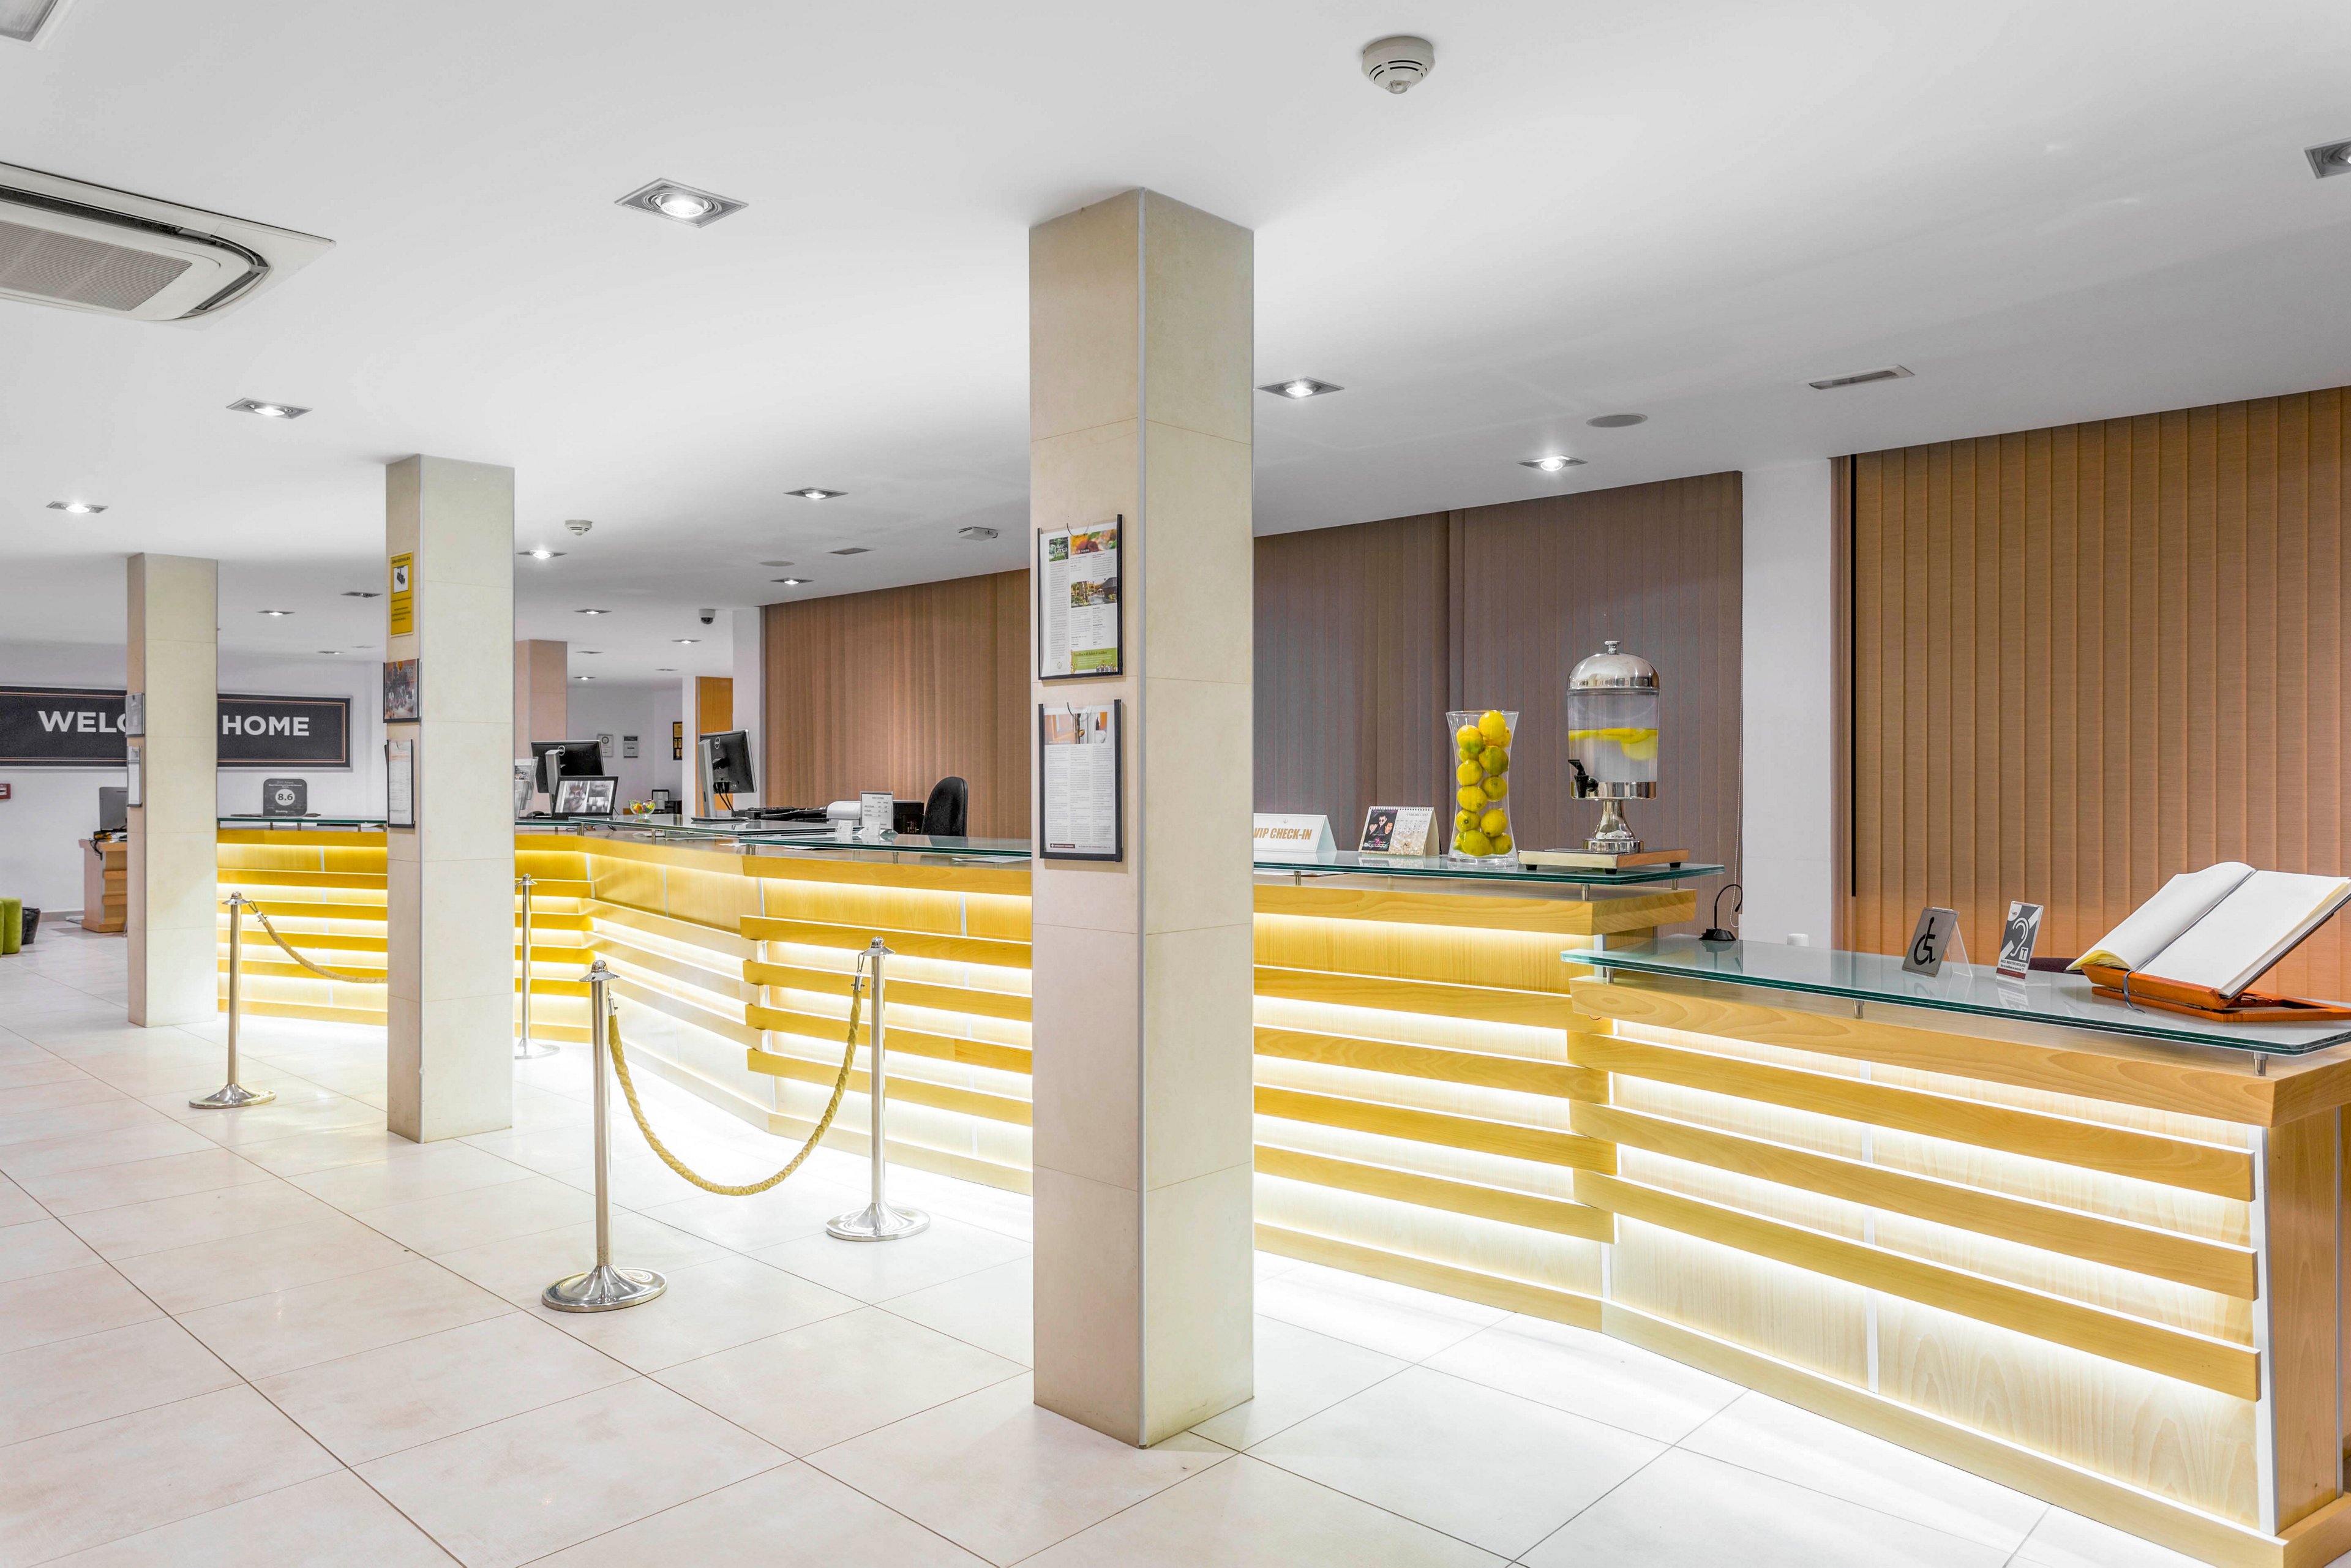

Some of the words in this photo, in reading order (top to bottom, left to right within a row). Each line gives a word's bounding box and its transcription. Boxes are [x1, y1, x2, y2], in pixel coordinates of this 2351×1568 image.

[223, 715, 309, 735] HOME
[1253, 828, 1269, 838] VIP
[1270, 828, 1312, 839] CHECK-IN
